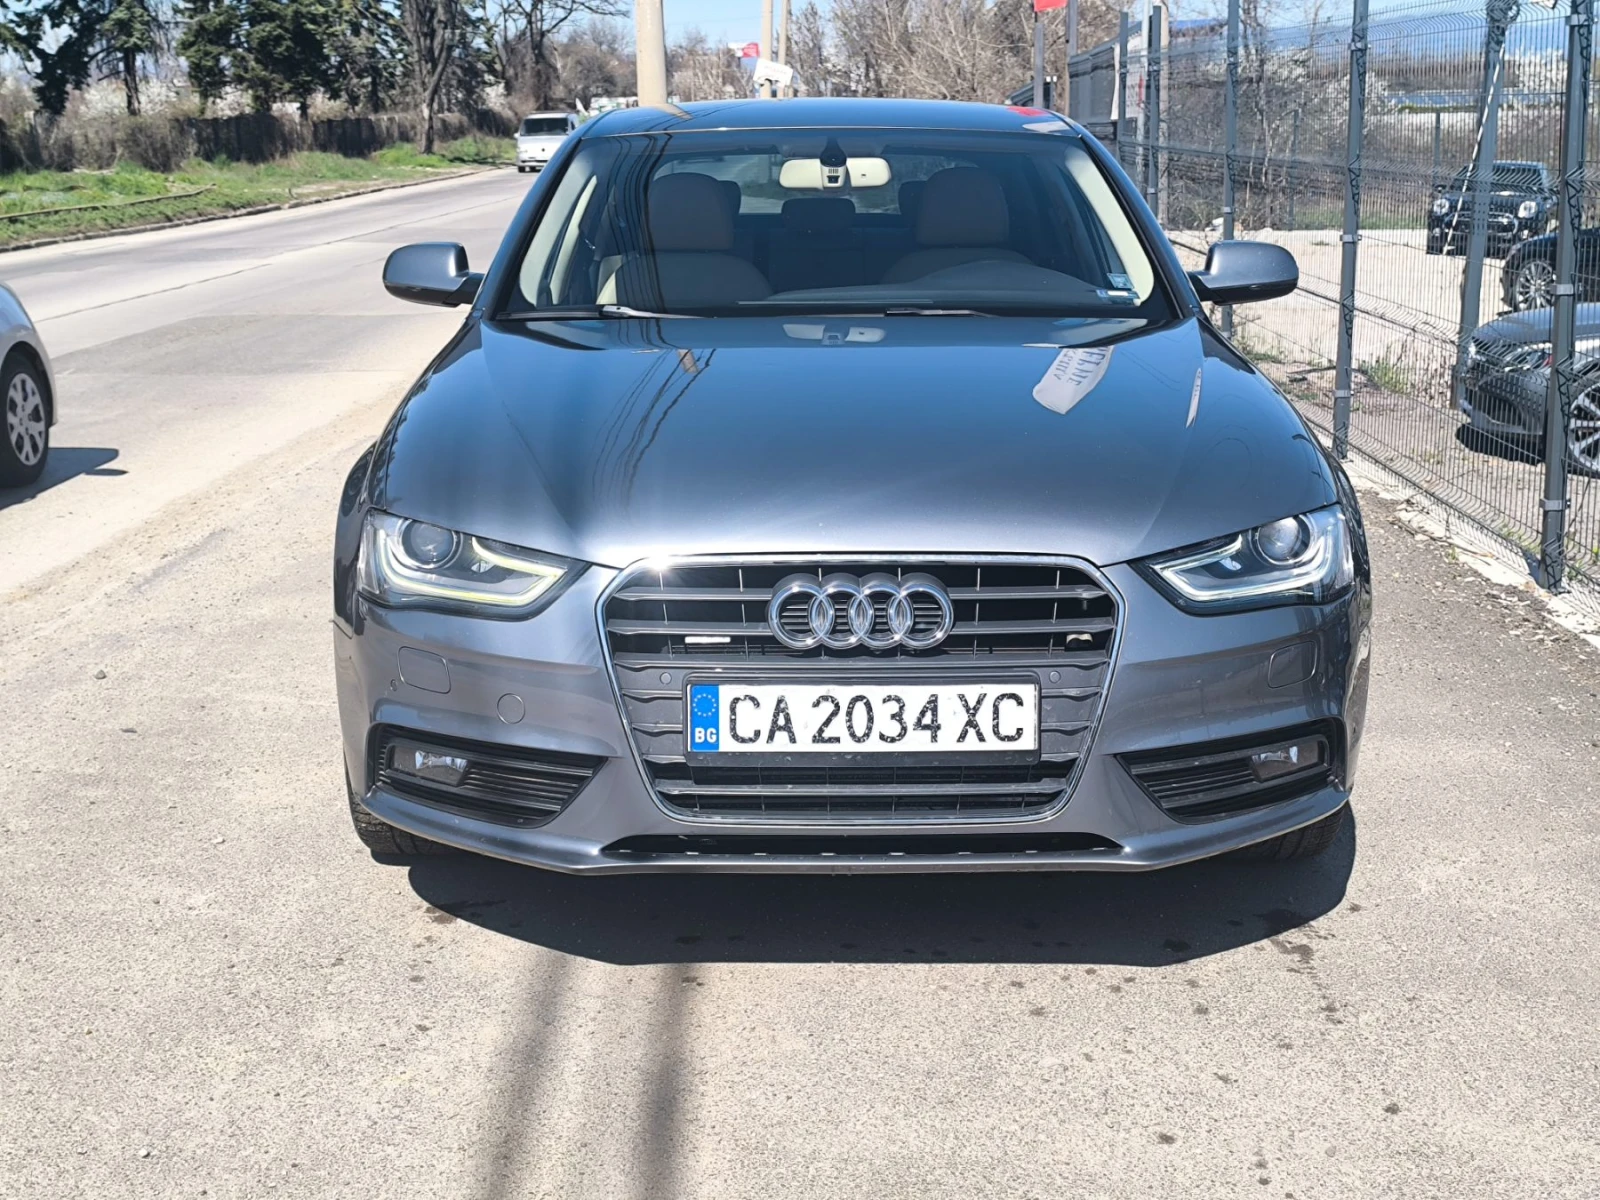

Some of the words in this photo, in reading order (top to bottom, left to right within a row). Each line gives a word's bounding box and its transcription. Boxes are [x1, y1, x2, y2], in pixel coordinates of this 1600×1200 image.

[729, 694, 797, 744] CA
[811, 694, 941, 744] 2034
[956, 692, 1024, 743] XC
[694, 727, 718, 744] BG
